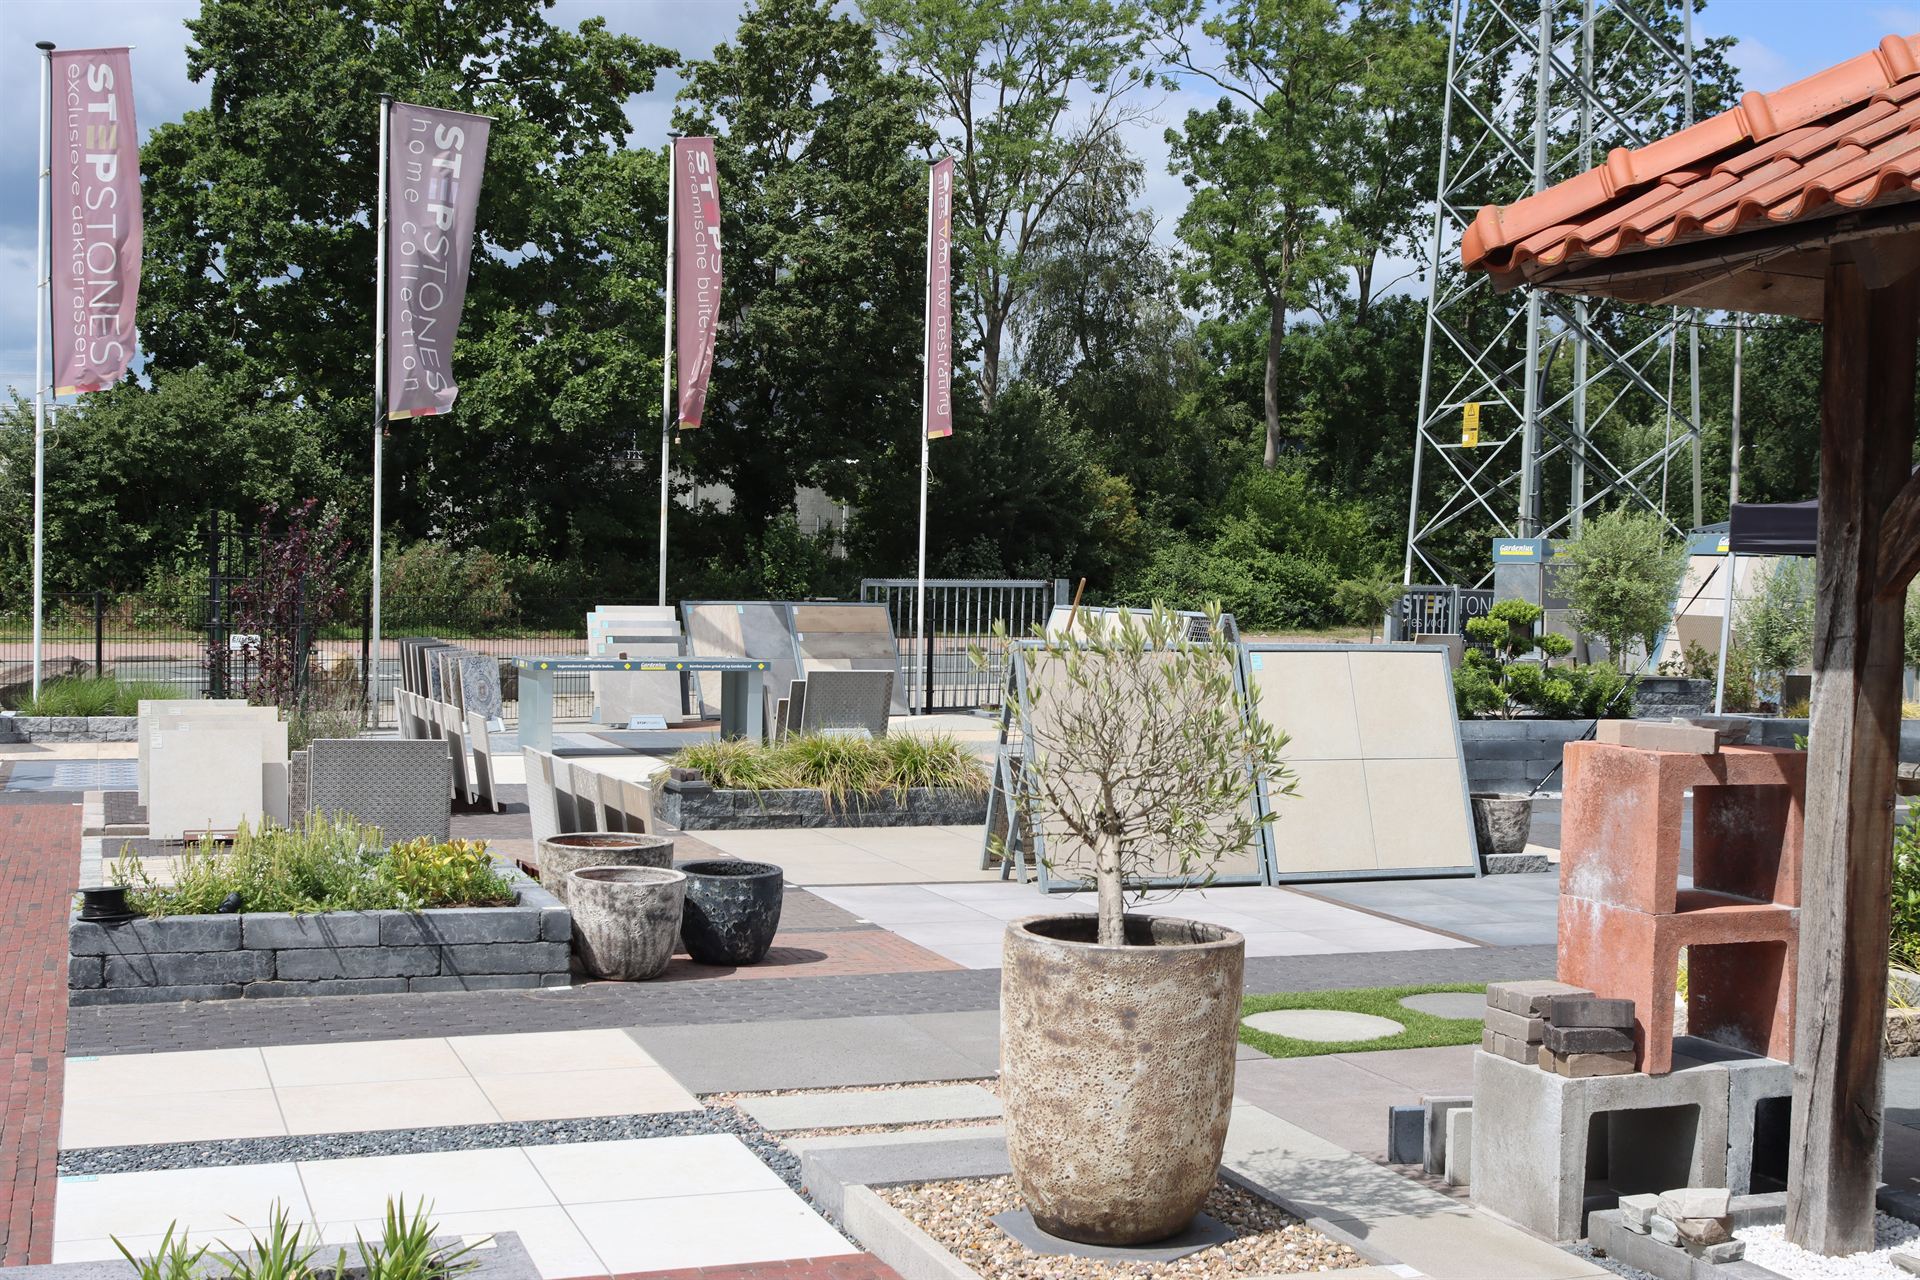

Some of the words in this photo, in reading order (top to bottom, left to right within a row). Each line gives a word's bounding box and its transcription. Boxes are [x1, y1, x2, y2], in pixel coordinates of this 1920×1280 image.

[66, 63, 84, 195] exclusieve
[404, 118, 432, 203] home
[86, 63, 124, 366] STEPSTONES
[417, 122, 466, 392] STEPSTONES
[686, 149, 709, 269] keramische
[70, 203, 88, 368] dakterrassen
[399, 221, 421, 391] collection
[1499, 544, 1535, 553] Gardenlux
